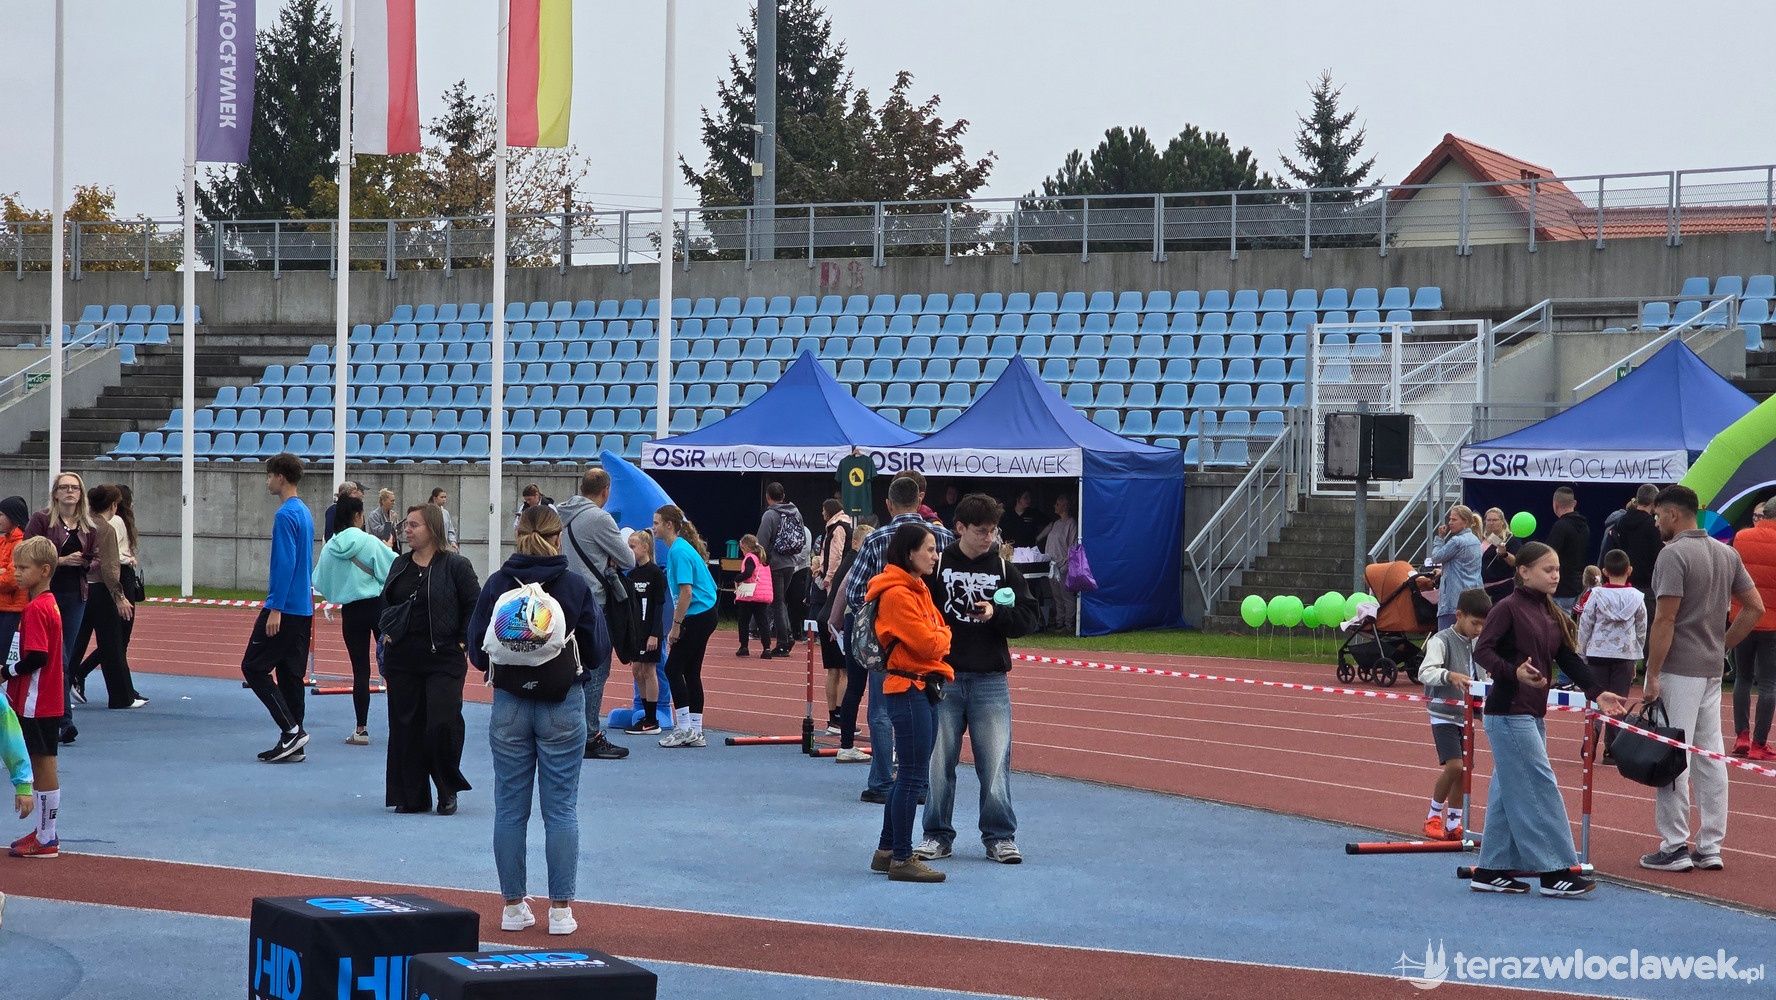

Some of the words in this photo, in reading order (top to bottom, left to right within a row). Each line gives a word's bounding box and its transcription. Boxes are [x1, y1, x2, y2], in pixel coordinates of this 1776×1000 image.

[653, 447, 706, 468] OSiR
[712, 450, 838, 469] WŁOCŁAWEK
[869, 450, 925, 473] OSiR
[931, 454, 1069, 474] WŁOCŁAWEK
[1472, 453, 1530, 477] OSiR
[1535, 457, 1673, 479] WŁOCŁAWEK
[522, 681, 539, 690] 4F
[254, 937, 303, 1000] HID
[447, 952, 589, 969] HID
[337, 956, 413, 1000] HI
